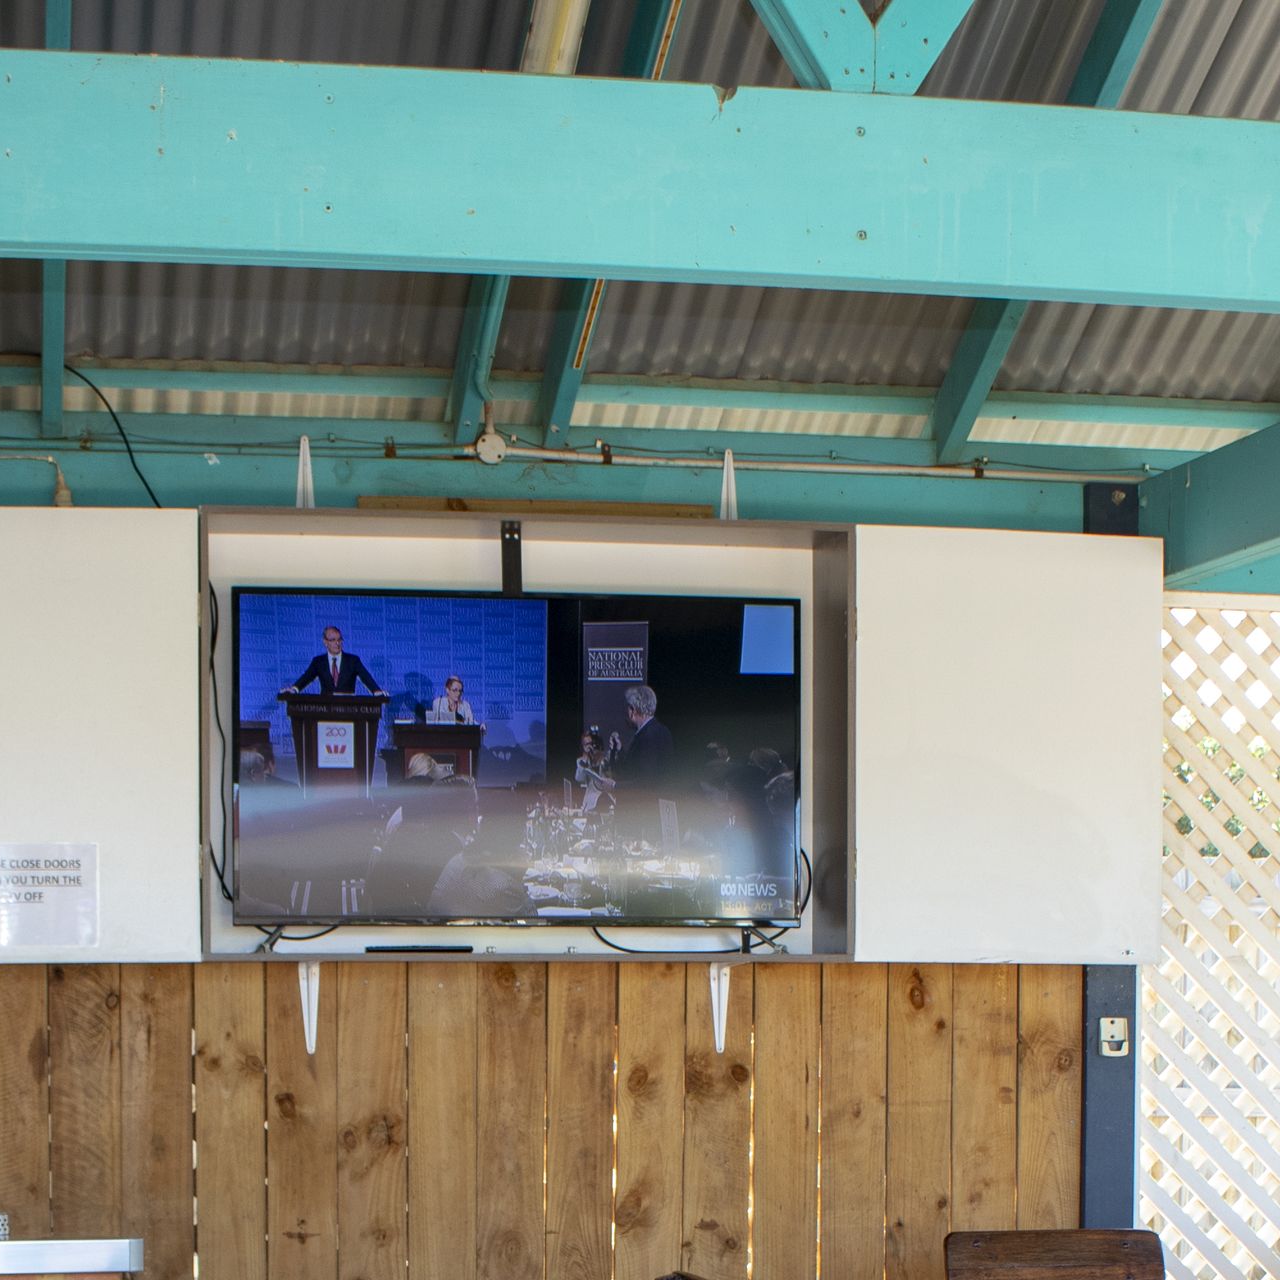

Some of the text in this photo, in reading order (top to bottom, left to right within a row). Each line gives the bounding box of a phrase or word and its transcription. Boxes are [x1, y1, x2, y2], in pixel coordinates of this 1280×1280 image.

[588, 651, 641, 661] NATIONAL
[588, 659, 644, 670] PRESS CLUB
[588, 669, 643, 677] OF AUSTRALIA
[325, 727, 347, 738] 200
[9, 858, 42, 869] CLOSE
[44, 858, 82, 869] DOORS
[5, 875, 28, 886] YOU
[30, 875, 60, 886] TURN
[63, 875, 82, 886] THE
[738, 883, 777, 897] NEWS
[24, 891, 45, 903] OFF
